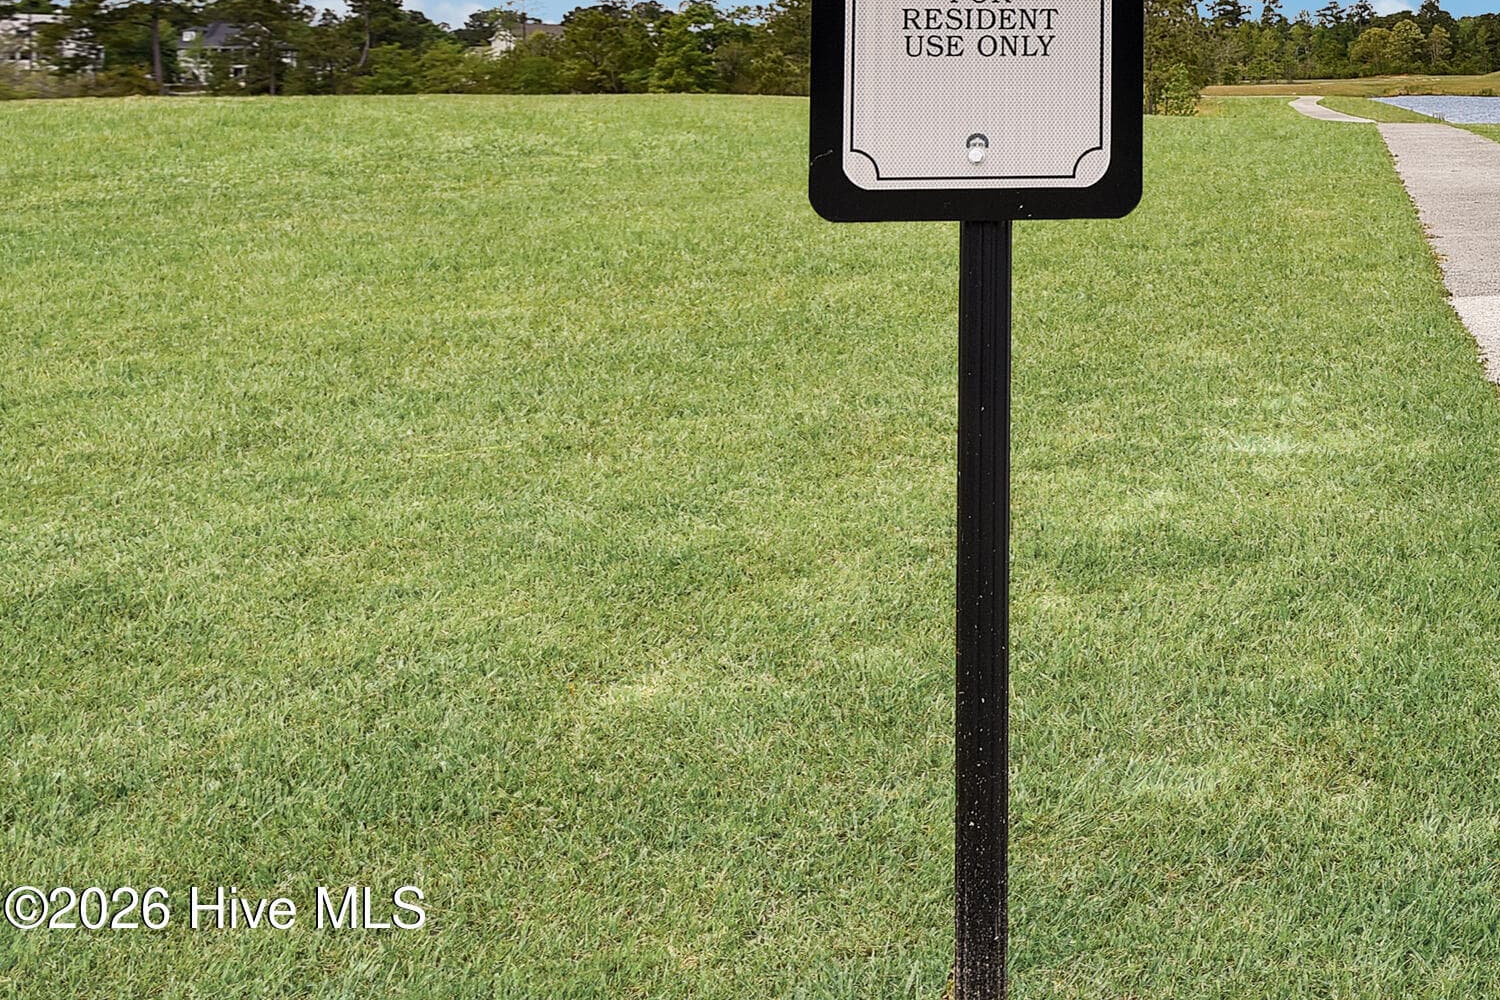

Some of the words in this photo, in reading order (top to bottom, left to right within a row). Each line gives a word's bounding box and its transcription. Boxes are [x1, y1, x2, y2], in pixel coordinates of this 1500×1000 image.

[902, 8, 1059, 31] RESIDENT
[904, 35, 964, 57] USE
[977, 35, 1056, 57] ONLY
